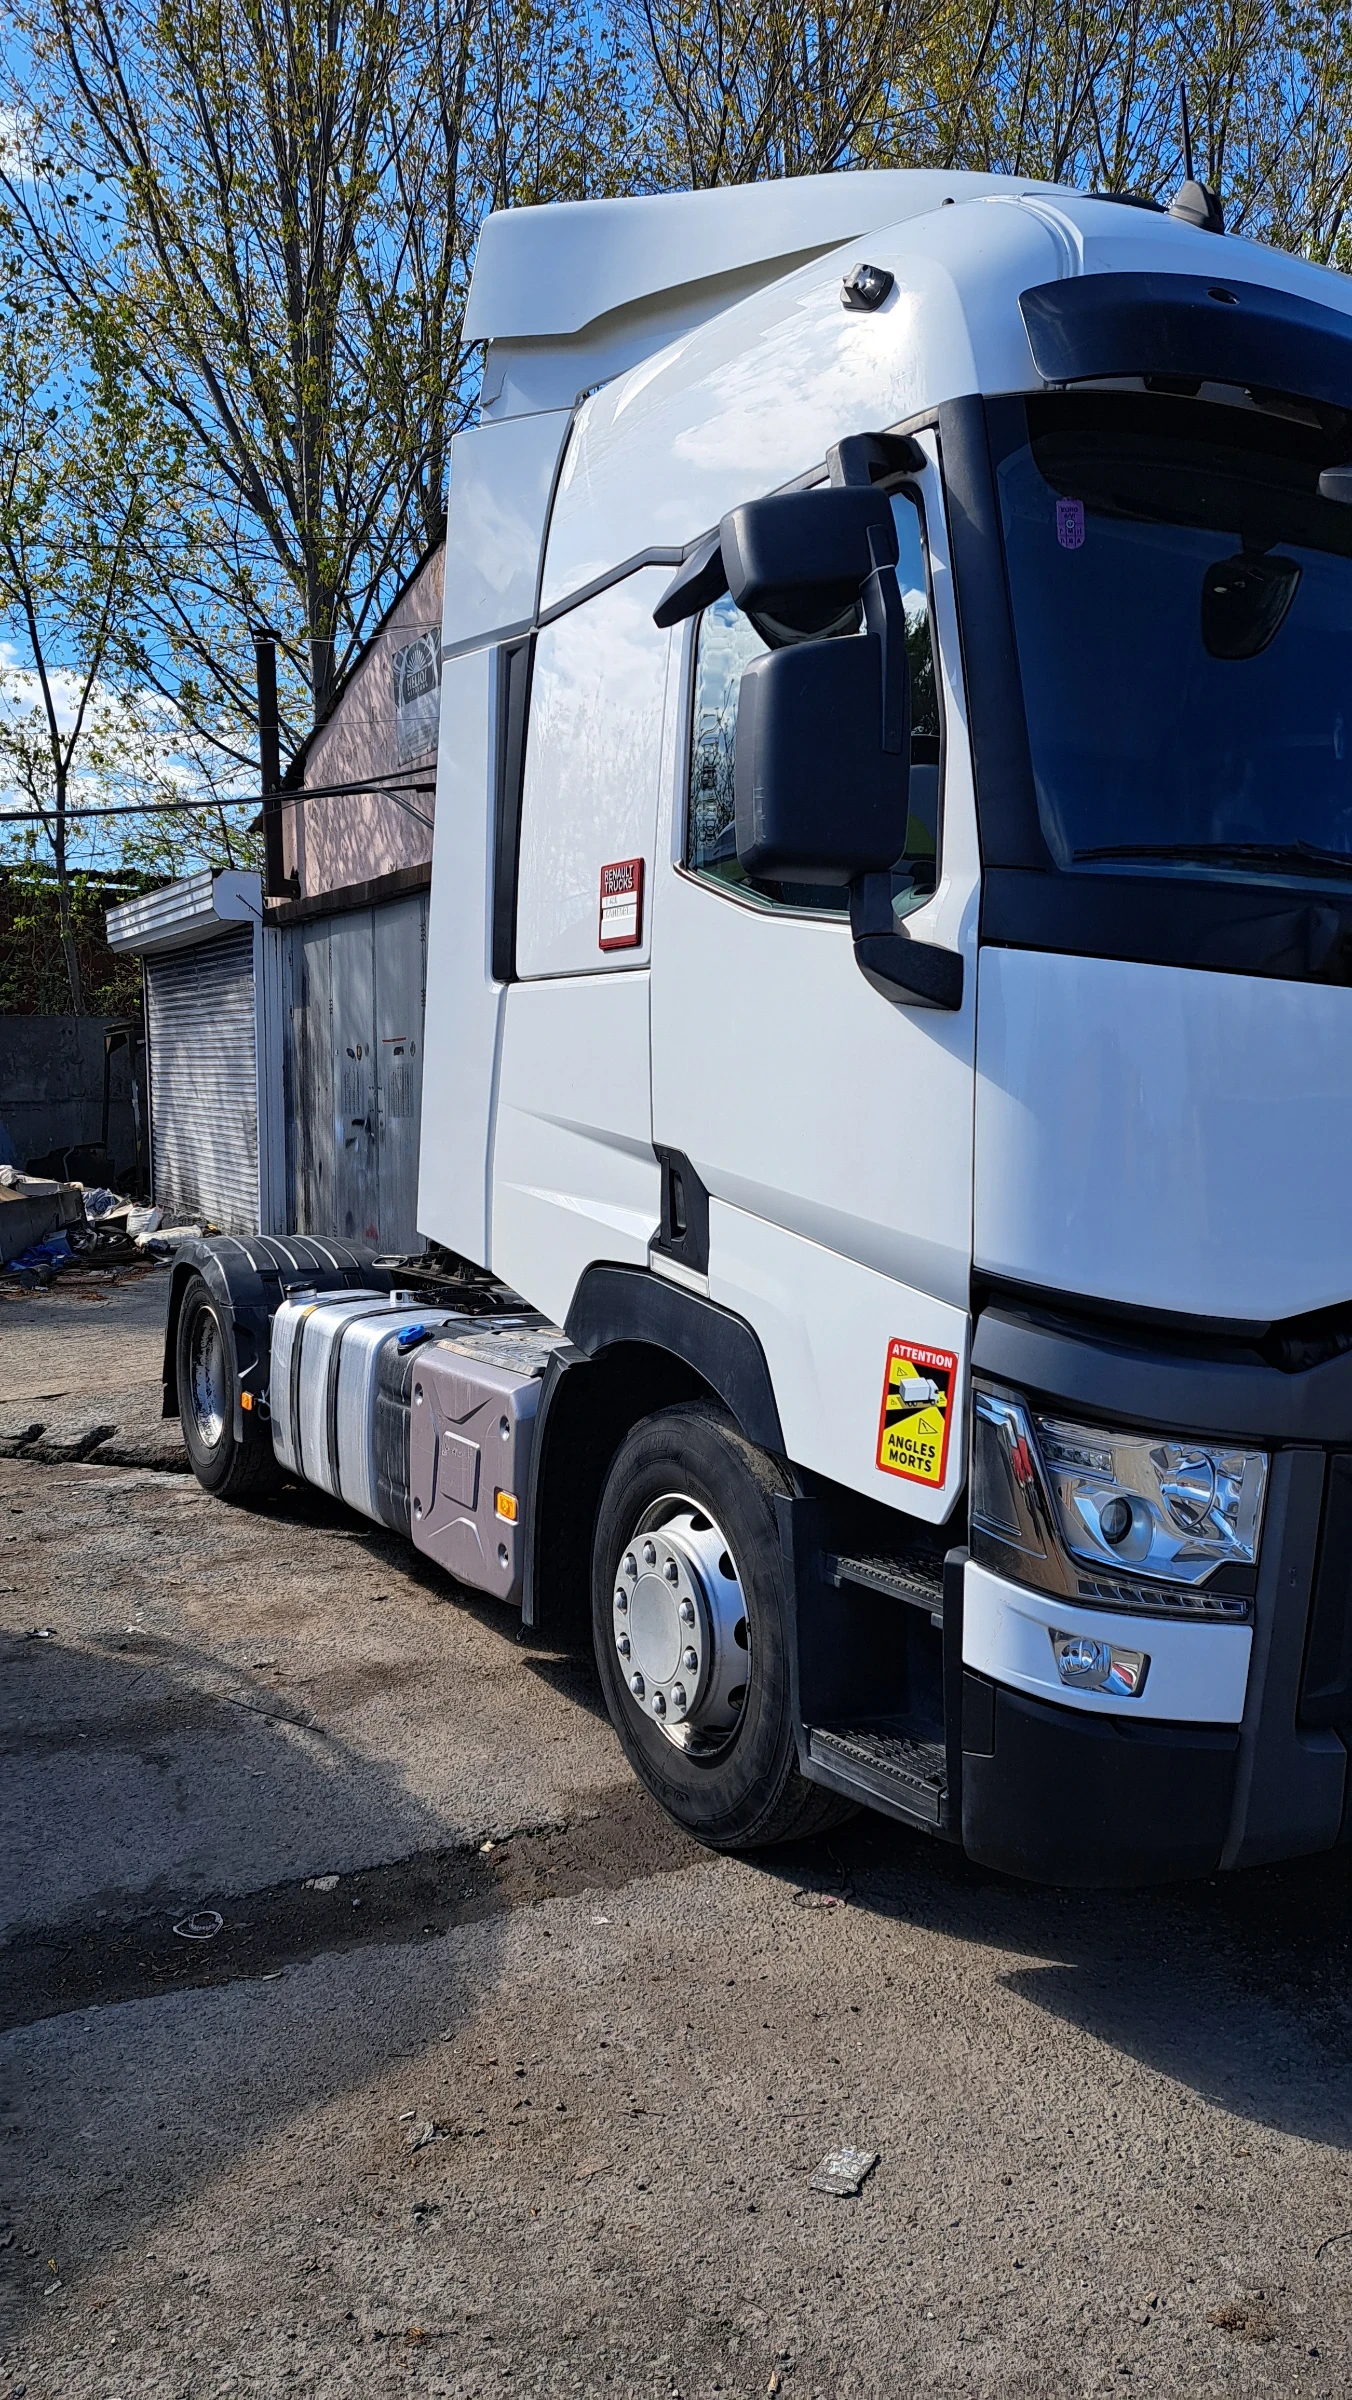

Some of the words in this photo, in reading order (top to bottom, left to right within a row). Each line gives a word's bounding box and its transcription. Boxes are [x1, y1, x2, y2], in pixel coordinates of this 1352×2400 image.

[406, 668, 427, 691] HELIOS
[604, 865, 633, 882] RENAULT
[604, 877, 633, 893] TRUCKS
[892, 1343, 952, 1368] ATTENTION
[888, 1433, 936, 1458] ANGLES
[889, 1449, 932, 1473] MORTS
